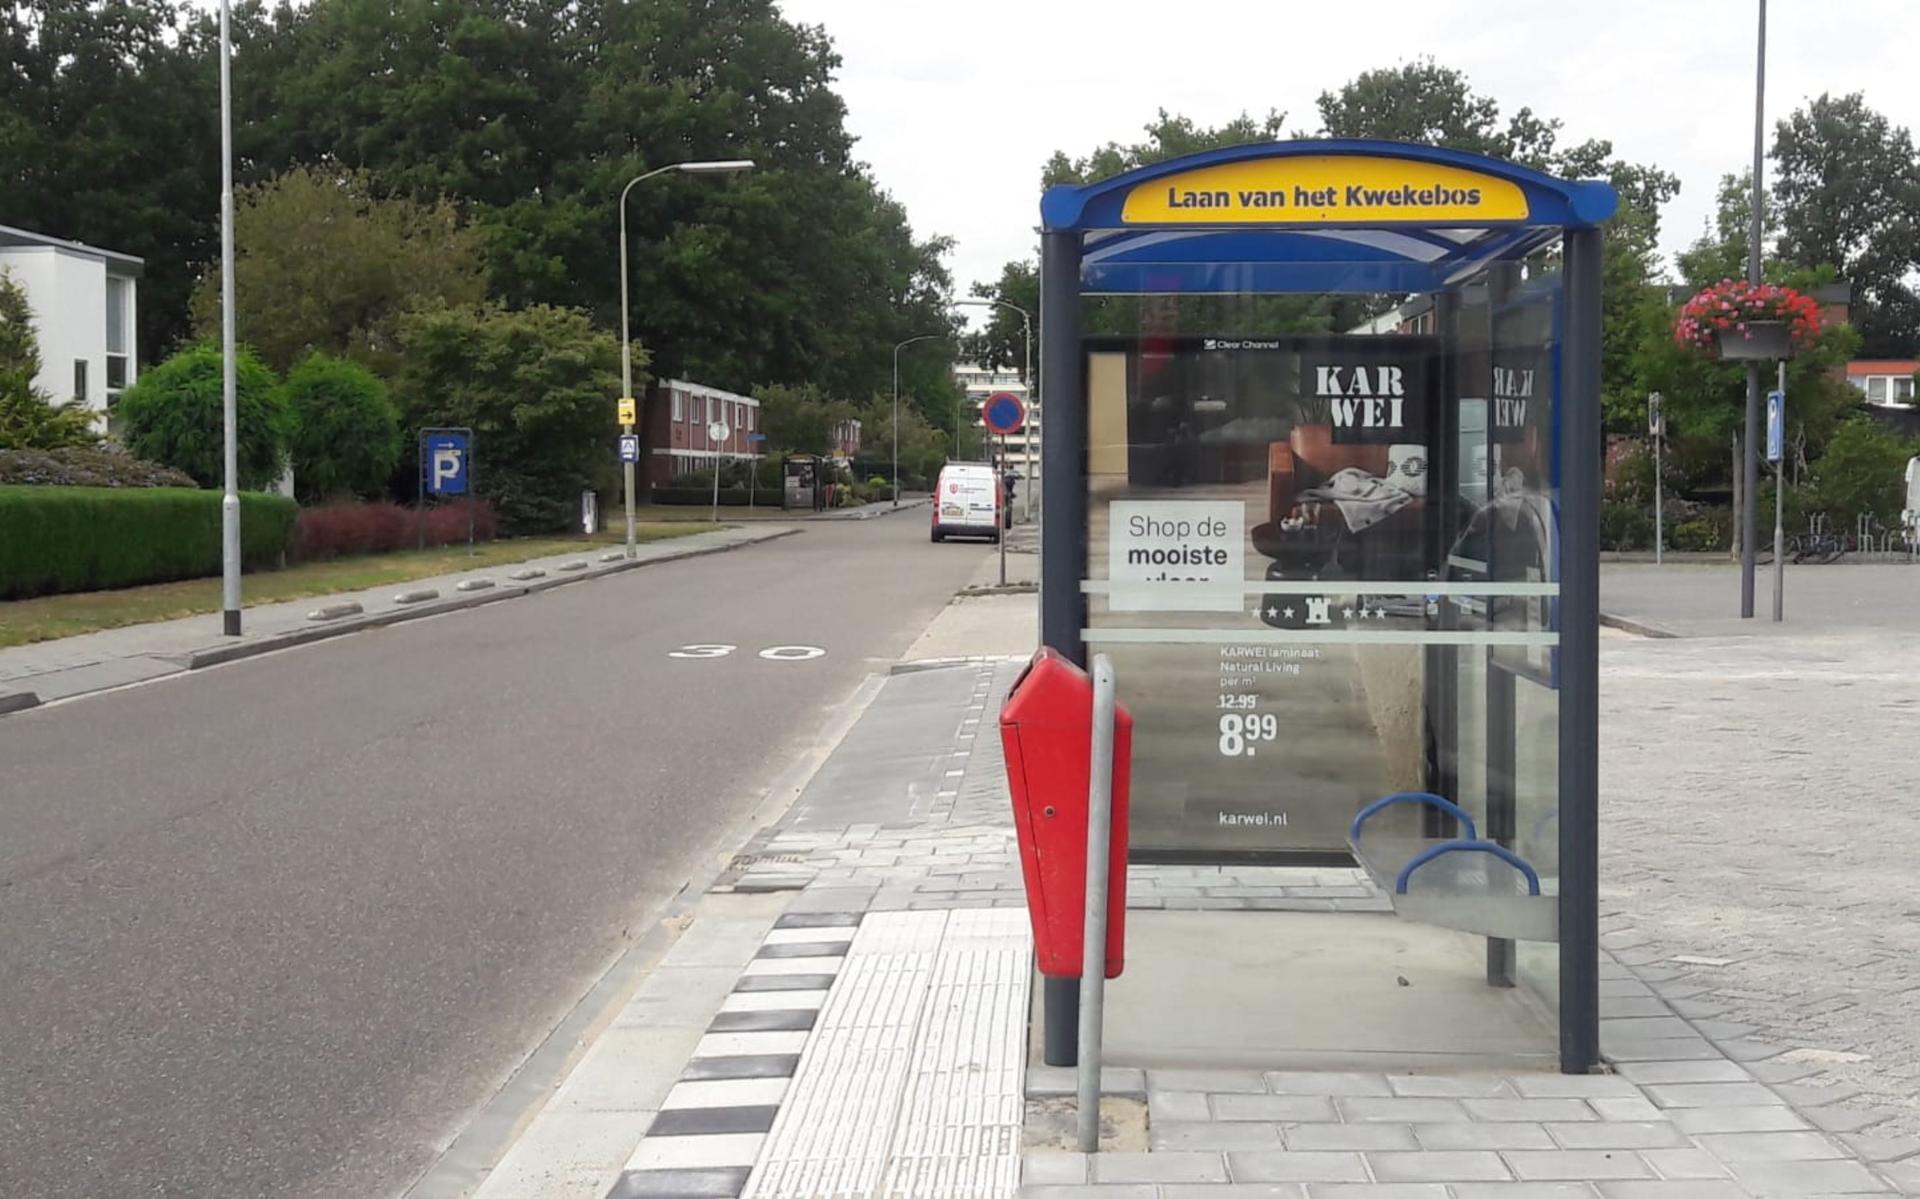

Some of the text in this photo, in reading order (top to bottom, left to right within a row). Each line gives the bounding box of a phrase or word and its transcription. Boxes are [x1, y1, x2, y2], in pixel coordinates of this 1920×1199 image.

[1168, 184, 1481, 208] Laan van het Kwekebos
[1217, 340, 1280, 349] Clear Channel
[1316, 365, 1405, 396] KAR
[1331, 398, 1404, 427] WEI
[434, 450, 461, 489] P
[1129, 515, 1227, 541] Shop de
[1128, 544, 1228, 566] mooiste
[1220, 647, 1320, 658] KARWEI laminaat
[1220, 662, 1300, 675] Natural Living
[1220, 677, 1238, 687] per
[1218, 694, 1257, 708] 12.99
[1219, 811, 1288, 826] karwei.nl
